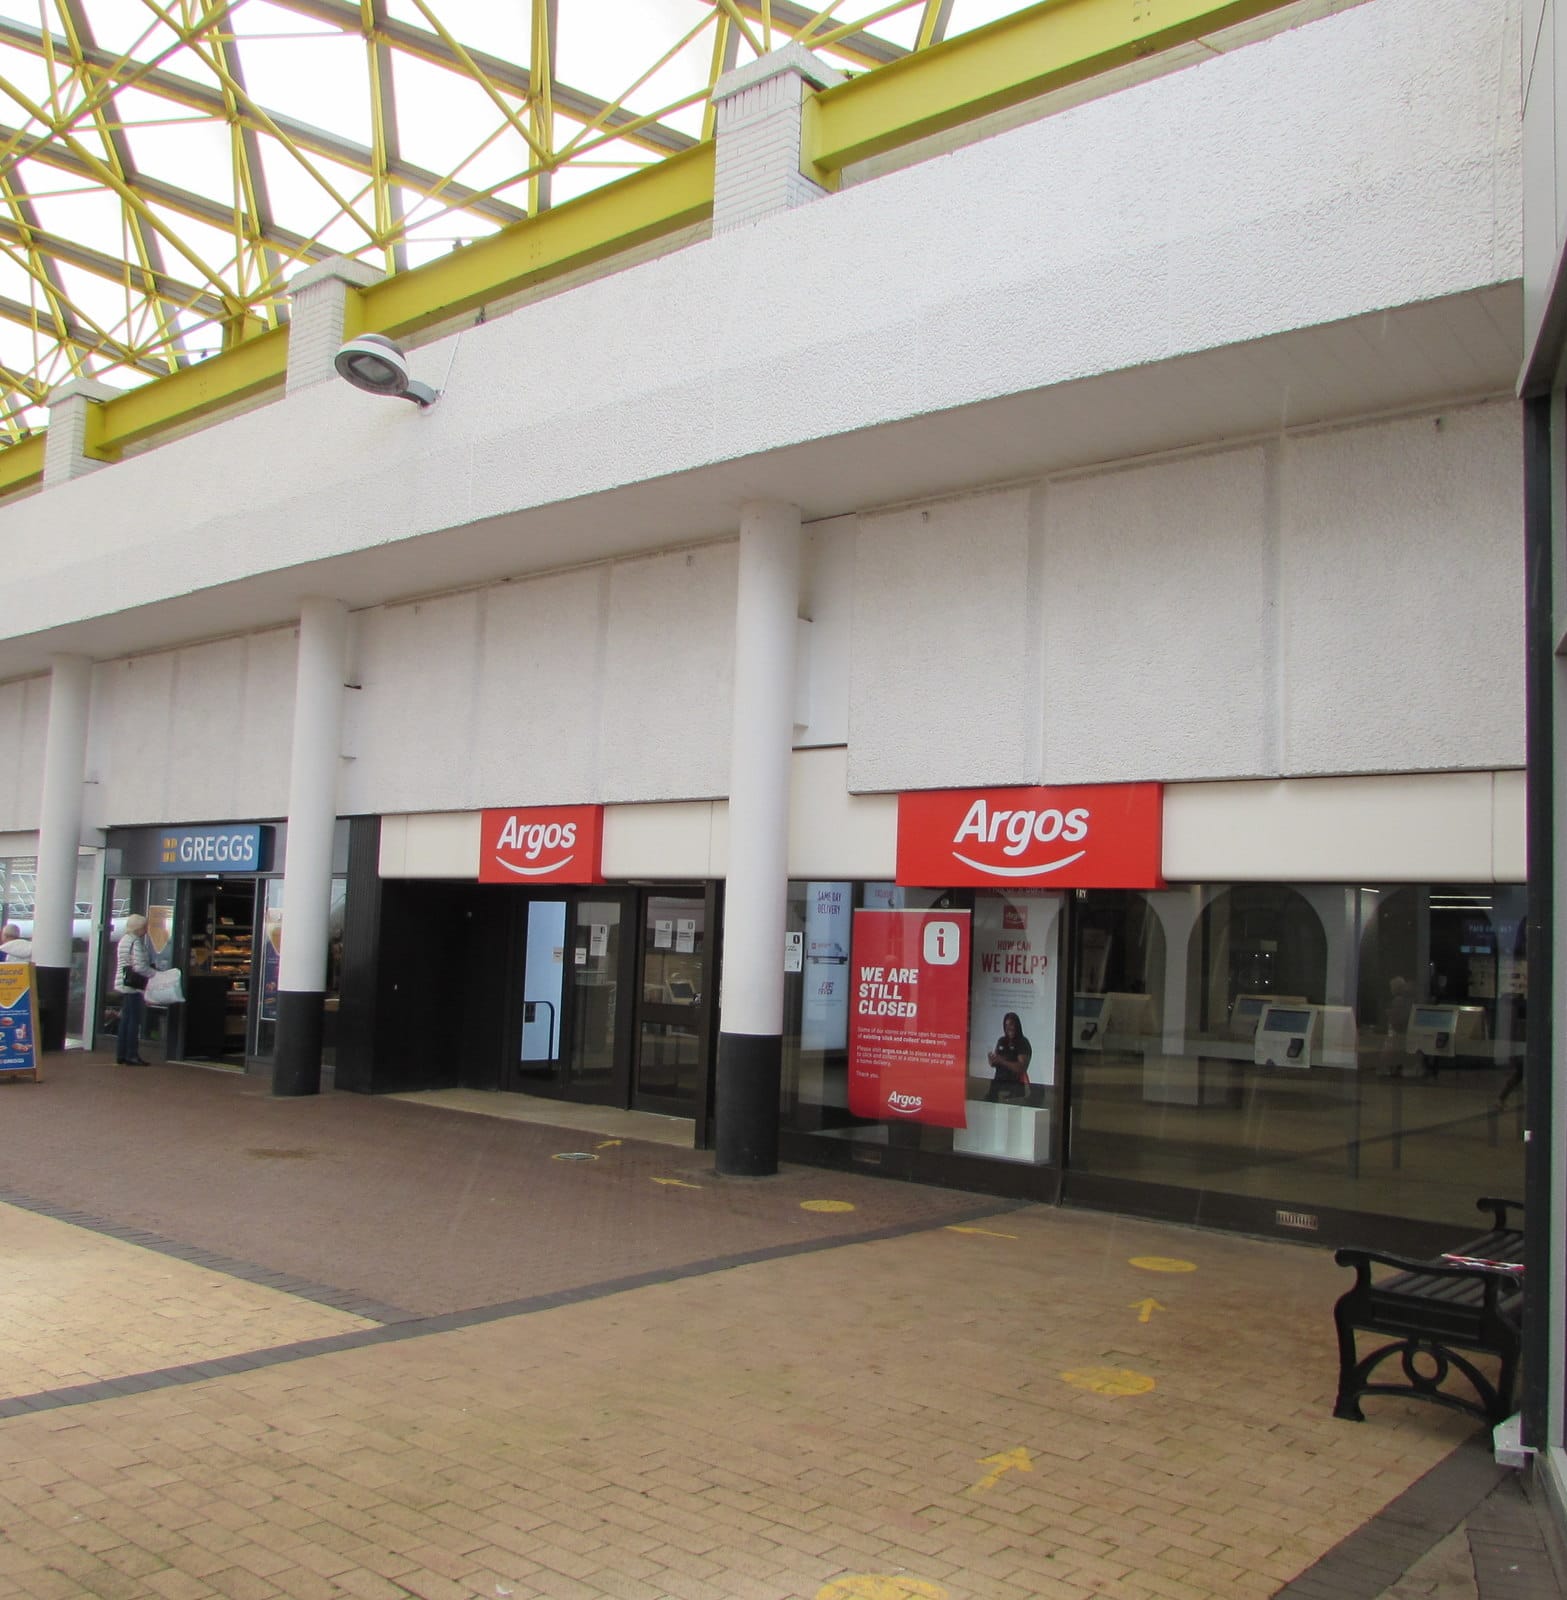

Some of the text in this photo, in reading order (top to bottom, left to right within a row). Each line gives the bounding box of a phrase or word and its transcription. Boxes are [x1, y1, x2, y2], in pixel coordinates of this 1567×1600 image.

[952, 799, 1090, 857] Argos
[496, 815, 578, 860] Argos
[180, 834, 254, 863] GREGGS
[817, 904, 841, 915] DELIVERY
[997, 940, 1032, 952] HOW CAN
[981, 954, 1048, 975] WE HELP?
[860, 966, 919, 984] WE ARE
[858, 982, 902, 1000] STILL
[858, 999, 918, 1018] CLOSED
[888, 1090, 922, 1108] Argos
